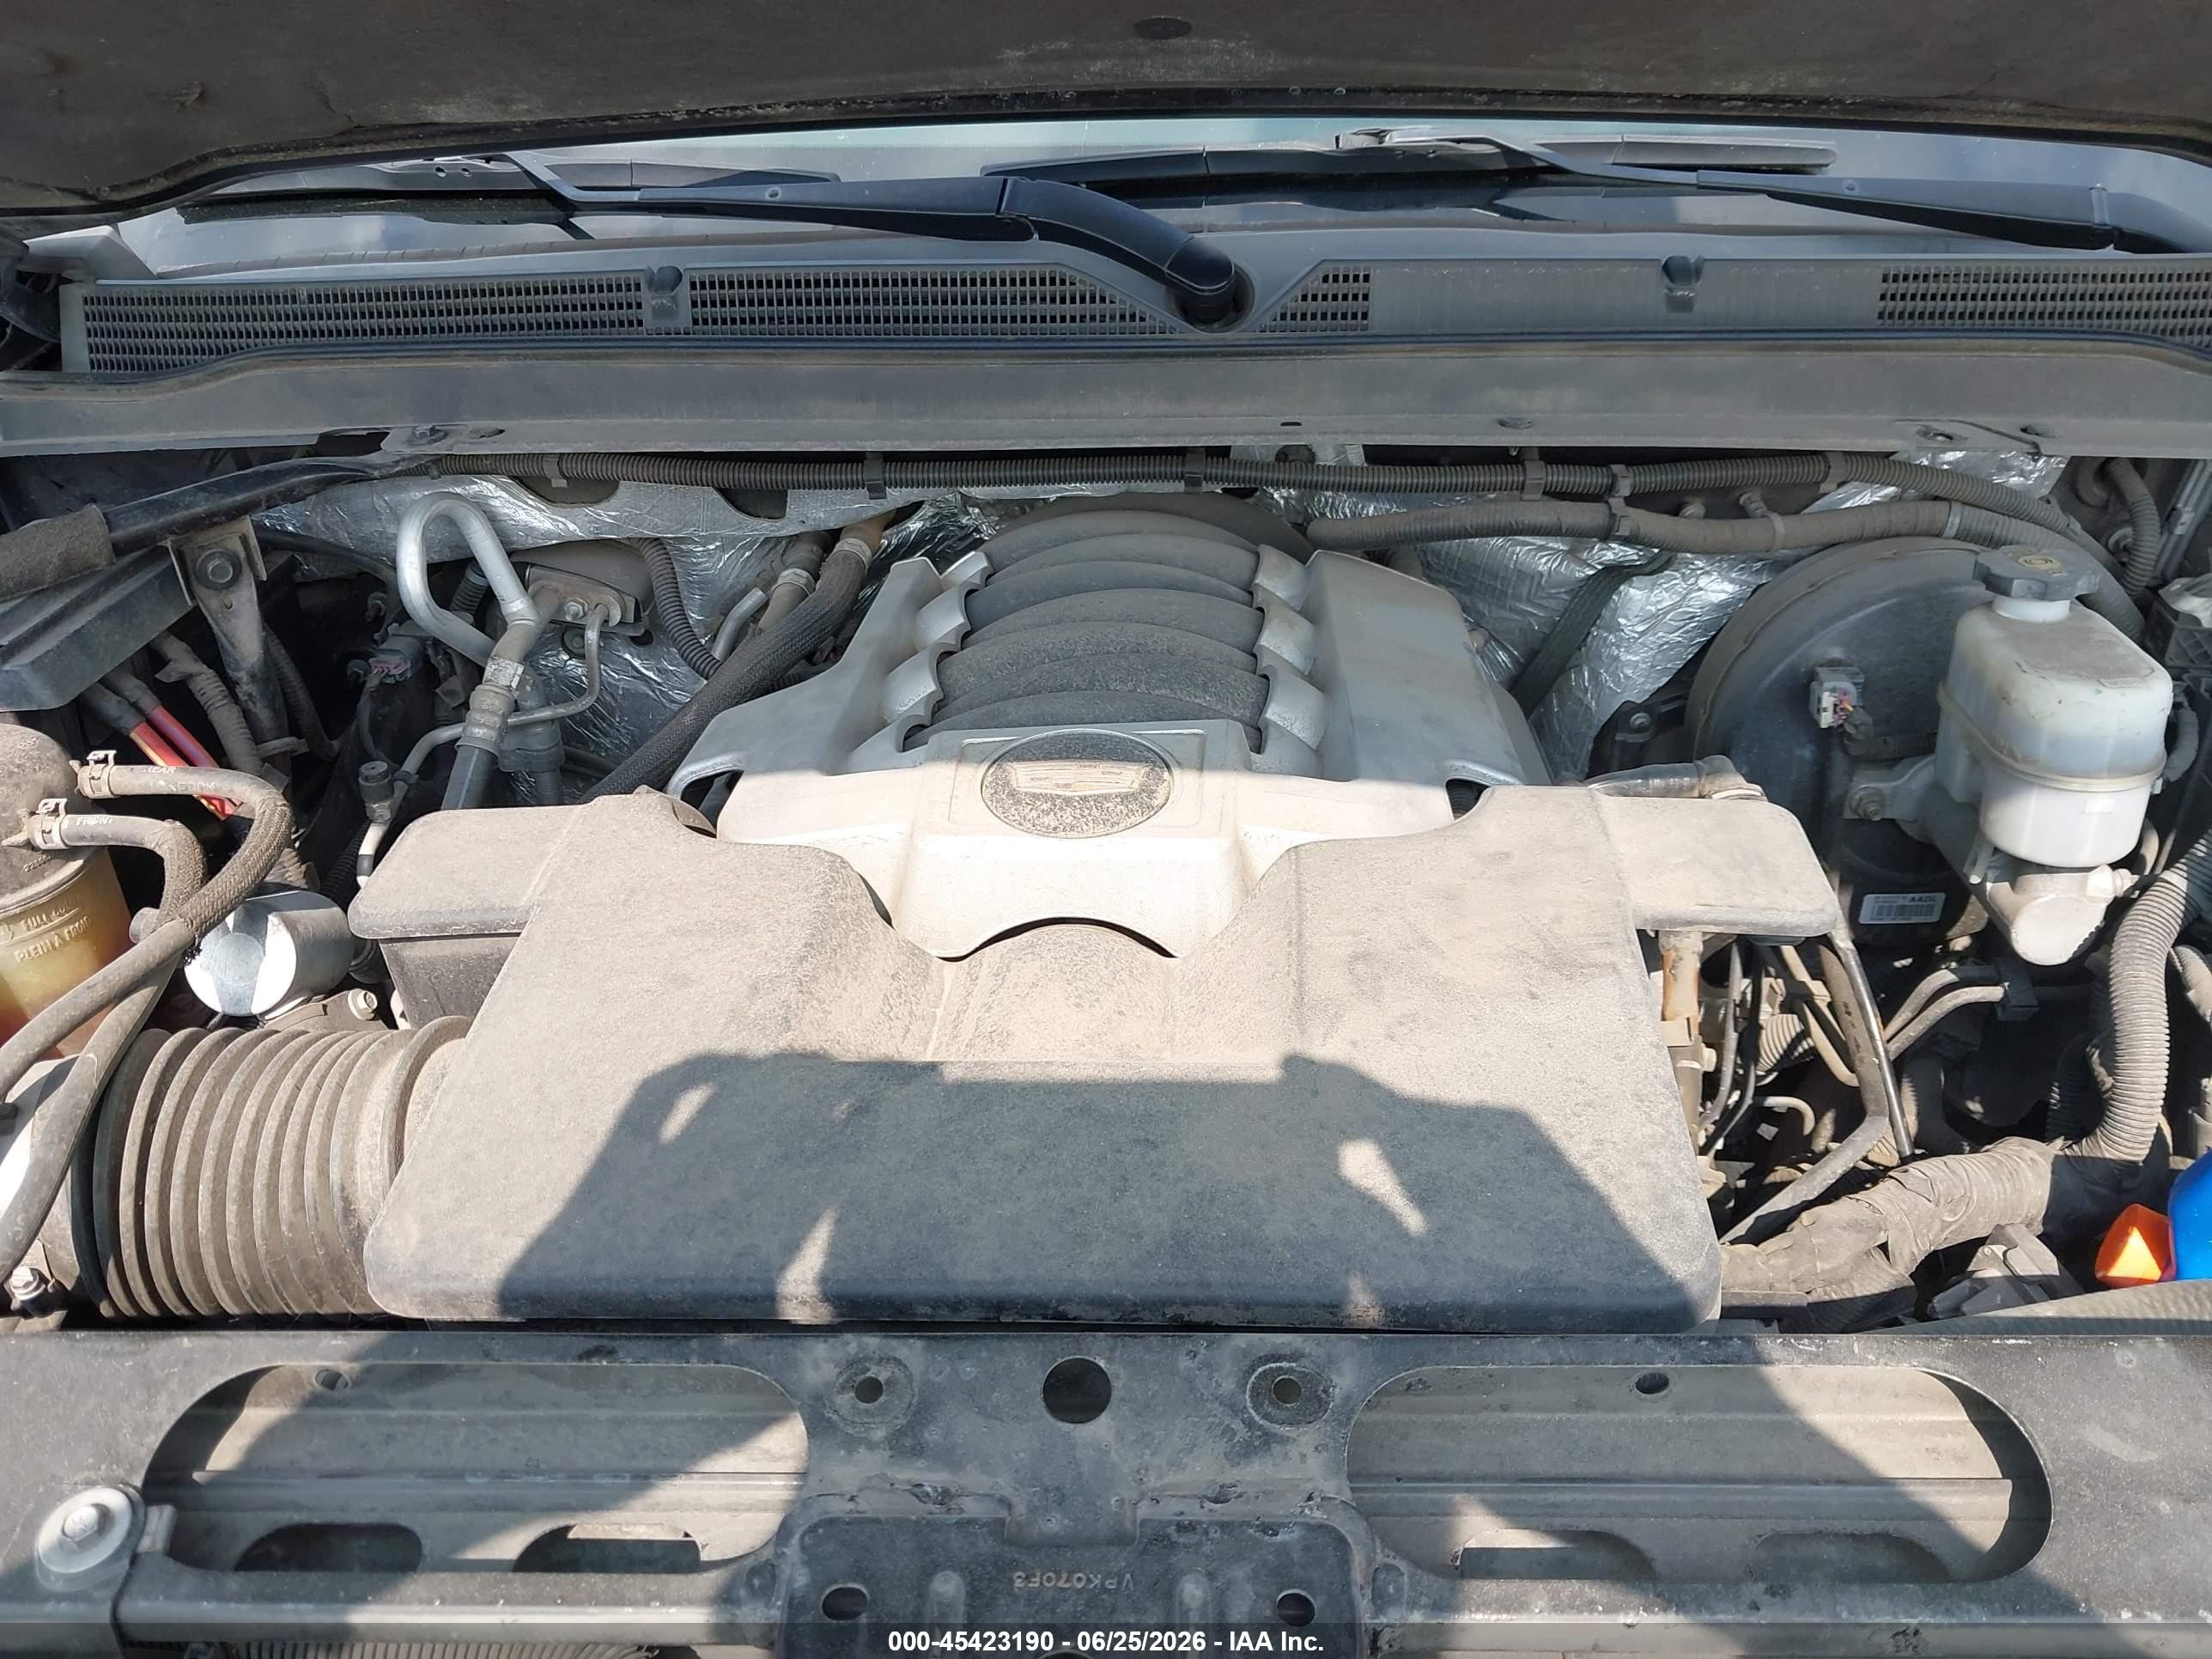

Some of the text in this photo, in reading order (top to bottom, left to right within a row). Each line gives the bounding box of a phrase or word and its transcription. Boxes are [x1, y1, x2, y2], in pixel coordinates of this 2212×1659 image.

[20, 912, 50, 932] FULL
[14, 939, 52, 963] PLEIN
[1012, 1571, 1134, 1590] VPK070F3
